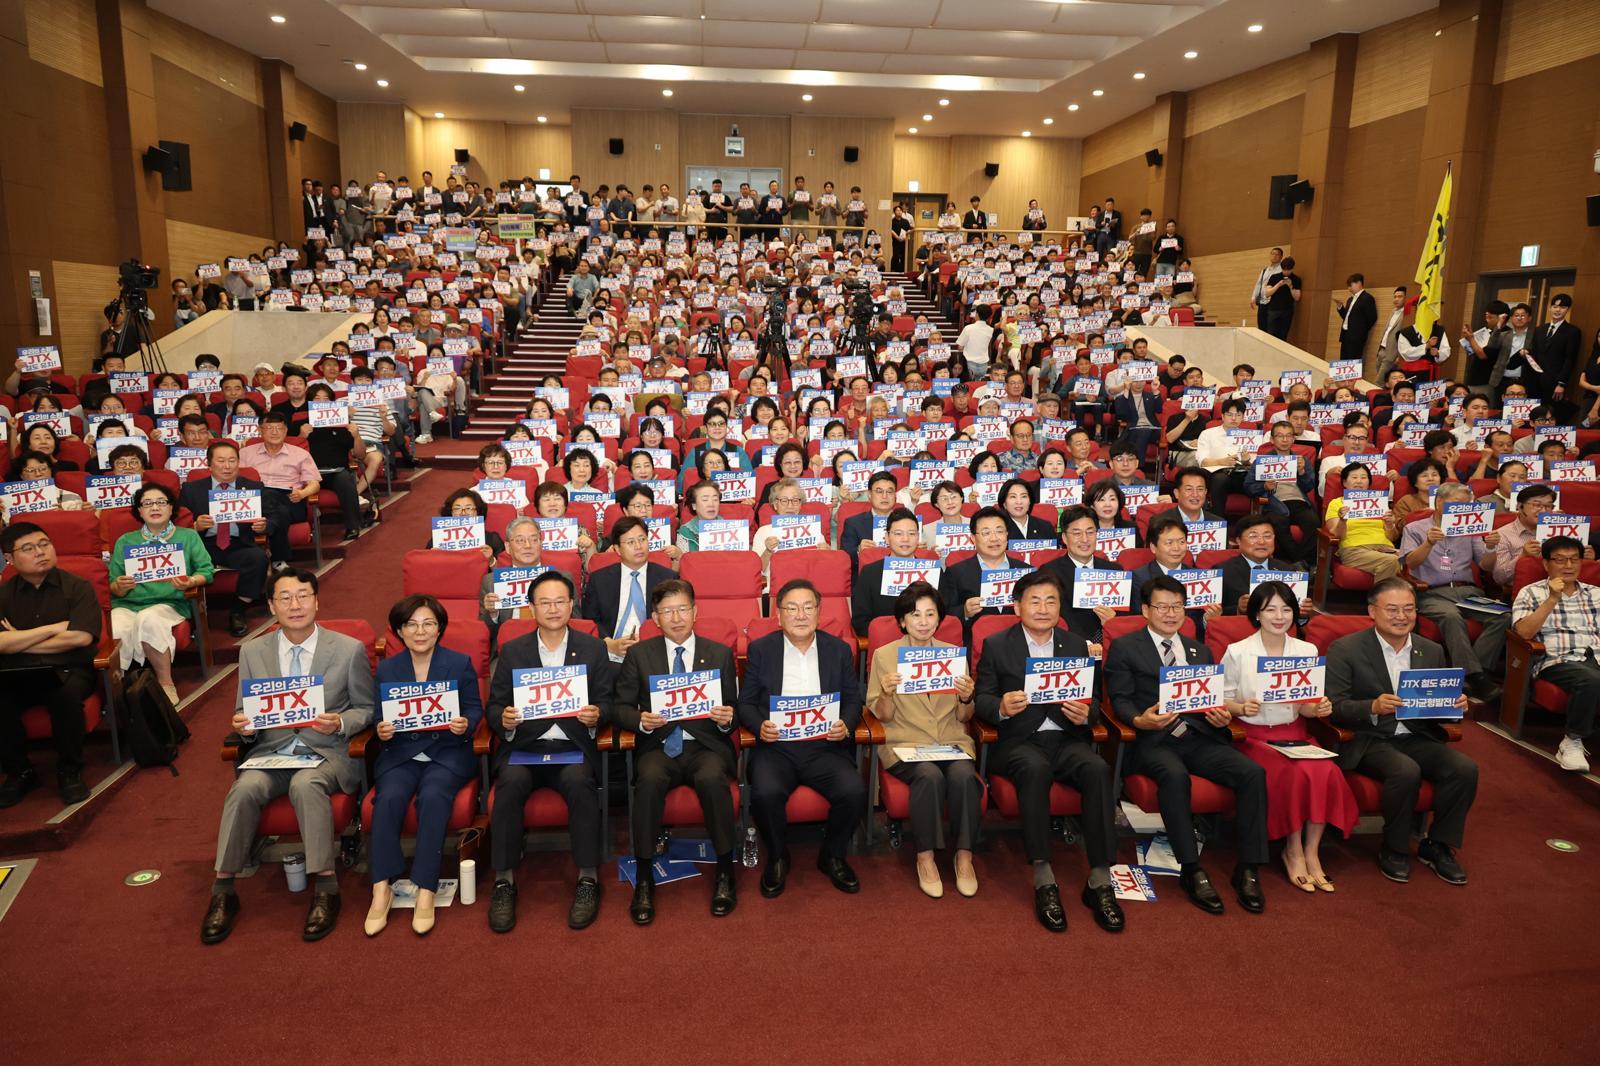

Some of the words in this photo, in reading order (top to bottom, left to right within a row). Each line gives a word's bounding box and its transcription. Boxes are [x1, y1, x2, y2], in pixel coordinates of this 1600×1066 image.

[1025, 331, 1038, 339] JTX
[27, 354, 52, 364] JTX
[843, 361, 859, 370] JTX
[1336, 366, 1356, 374] JTX
[118, 378, 140, 387] JTX
[798, 375, 814, 384] JTX
[355, 391, 376, 400] JTX
[1422, 386, 1442, 395] JTX
[1188, 395, 1208, 403] JTX
[317, 409, 339, 419] JTX
[1312, 410, 1332, 419] JTX
[979, 423, 1000, 432] JTX
[1049, 425, 1069, 434] JTX
[927, 430, 947, 439] JTX
[1233, 436, 1256, 445] JTX
[895, 440, 917, 449] JTX
[510, 449, 532, 459] JTX
[1264, 462, 1288, 473] JTX
[1560, 468, 1585, 479] JTX
[91, 477, 117, 486] 우리의
[118, 475, 136, 483] 소원!
[919, 469, 945, 480] JTX
[4, 483, 29, 493] 우리의
[31, 479, 49, 488] 소원!
[98, 484, 131, 498] JTX
[720, 479, 746, 492] JTX
[12, 489, 45, 505] JTX
[214, 491, 239, 499] 우리의
[488, 489, 516, 501] JTX
[1048, 487, 1073, 498] JTX
[9, 504, 30, 514] 철도
[31, 500, 52, 511] 유치!
[94, 499, 113, 509] 철도
[220, 499, 251, 512] JTX
[1353, 498, 1380, 509] JTX
[1449, 504, 1472, 513] 우리의
[215, 513, 233, 521] 철도
[235, 511, 256, 520] 유치!
[1348, 510, 1363, 518] 철도
[1365, 509, 1383, 517] 유치!
[1453, 512, 1485, 525] JTX
[1543, 516, 1567, 524] 우리의
[1568, 515, 1585, 523] 소원!
[437, 519, 460, 528] 우리의
[461, 517, 479, 525] 소원!
[777, 517, 798, 525] 우리의
[443, 527, 474, 541] JTX
[782, 525, 810, 539] JTX
[1447, 526, 1465, 535] 철도
[1467, 524, 1488, 533] 유치!
[1548, 525, 1580, 537] JTX
[709, 530, 739, 544] JTX
[778, 539, 794, 548] 철도
[795, 537, 815, 546] 유치!
[438, 541, 456, 550] 철도
[458, 538, 479, 548] 유치!
[1036, 540, 1052, 548] 소원!
[129, 546, 157, 557] 우리의
[159, 544, 177, 553] 소원!
[138, 553, 174, 571] JTX
[890, 561, 915, 569] 우리의
[917, 560, 936, 568] 소원!
[132, 572, 154, 583] 철도
[156, 567, 180, 578] 유치!
[1081, 572, 1106, 581] 우리의
[1108, 572, 1127, 580] 소원!
[1085, 582, 1120, 596] JTX
[1079, 597, 1099, 606] 철도
[1101, 596, 1125, 606] 유치!
[905, 650, 936, 661] 우리의
[937, 648, 959, 658] 소원!
[911, 660, 952, 679] JTX
[1033, 660, 1063, 672] 우리의
[1066, 658, 1088, 669] 소원!
[1264, 660, 1294, 671] 우리의
[1297, 658, 1319, 668] 소원!
[520, 670, 553, 685] 우리의
[555, 666, 579, 679] 소원!
[1166, 669, 1194, 681] 우리의
[1196, 666, 1217, 677] 소원!
[1270, 670, 1312, 689] JTX
[250, 680, 286, 694] 우리의
[288, 676, 315, 688] 소원!
[657, 676, 688, 690] 우리의
[690, 671, 714, 683] 소원!
[904, 680, 927, 692] 철도
[1039, 670, 1080, 690] JTX
[1401, 680, 1420, 688] JTX
[1421, 679, 1438, 688] 철도
[1439, 678, 1460, 687] 유치!
[388, 685, 423, 699] 우리의
[425, 682, 450, 693] 소원!
[528, 680, 573, 704] JTX
[1031, 690, 1054, 702] 철도
[1057, 687, 1085, 700] 유치!
[1172, 678, 1210, 699] JTX
[1263, 690, 1286, 701] 철도
[1289, 686, 1317, 699] 유치!
[260, 690, 308, 713] JTX
[665, 684, 708, 707] JTX
[398, 694, 444, 717] JTX
[522, 704, 547, 718] 철도
[550, 697, 580, 713] 유치!
[777, 698, 808, 711] 우리의
[810, 695, 833, 706] 소원!
[1165, 699, 1186, 712] 철도
[1189, 695, 1216, 708] 유치!
[659, 706, 684, 719] 철도
[686, 700, 715, 715] 유치!
[253, 713, 281, 727] 철도
[284, 707, 316, 723] 유치!
[392, 717, 418, 730] 철도
[420, 712, 452, 726] 유치!
[784, 706, 826, 727] JTX
[778, 727, 801, 739] 철도
[804, 722, 832, 736] 유치!
[1114, 870, 1141, 893] JTX
